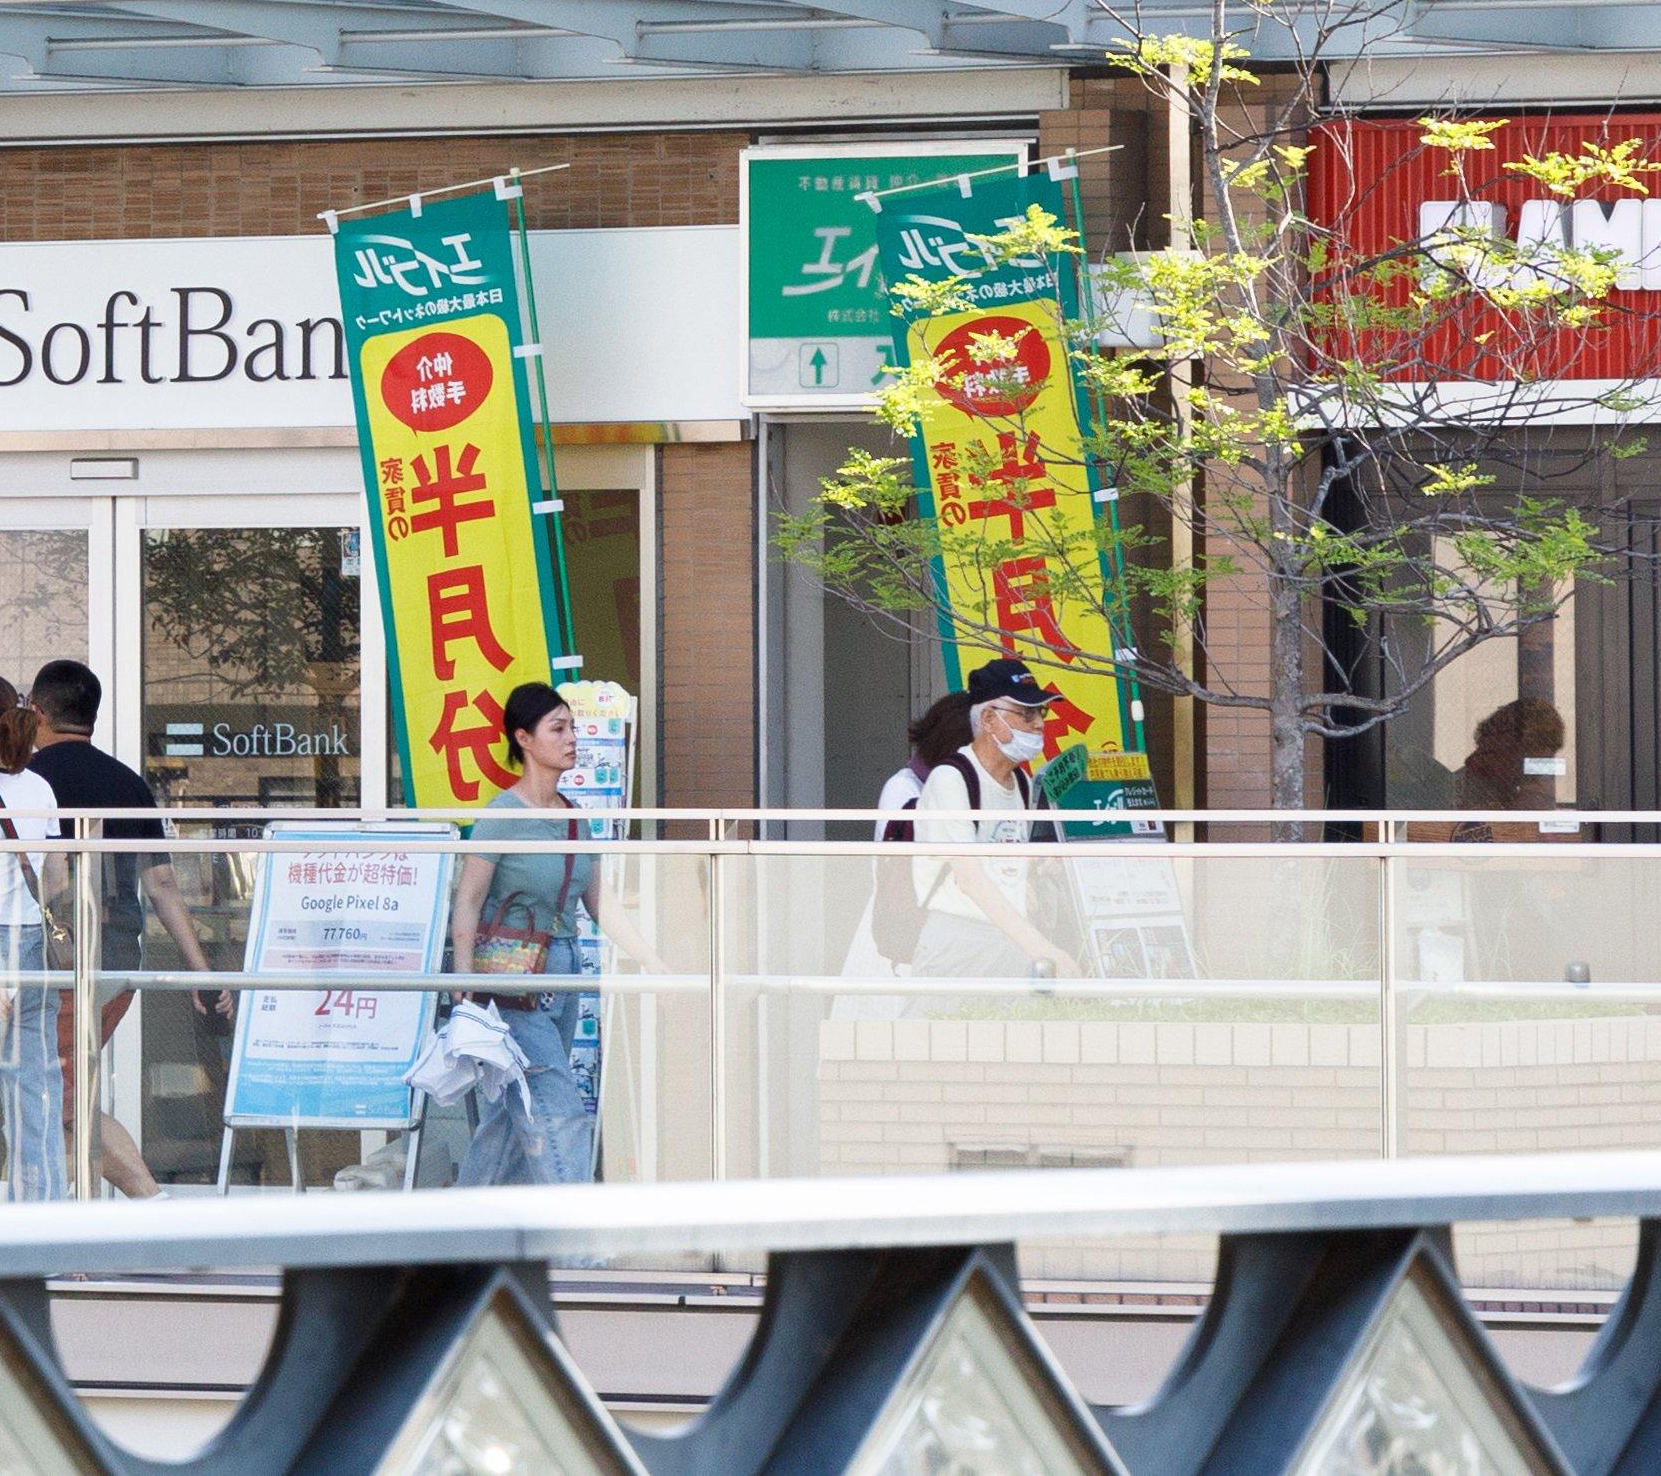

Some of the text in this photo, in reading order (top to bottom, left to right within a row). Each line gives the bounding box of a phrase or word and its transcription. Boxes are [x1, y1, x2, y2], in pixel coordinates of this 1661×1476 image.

[213, 722, 350, 756] SoftBank
[288, 862, 418, 886] 機種代金が超特価!
[301, 895, 399, 913] Google Pixel 8a
